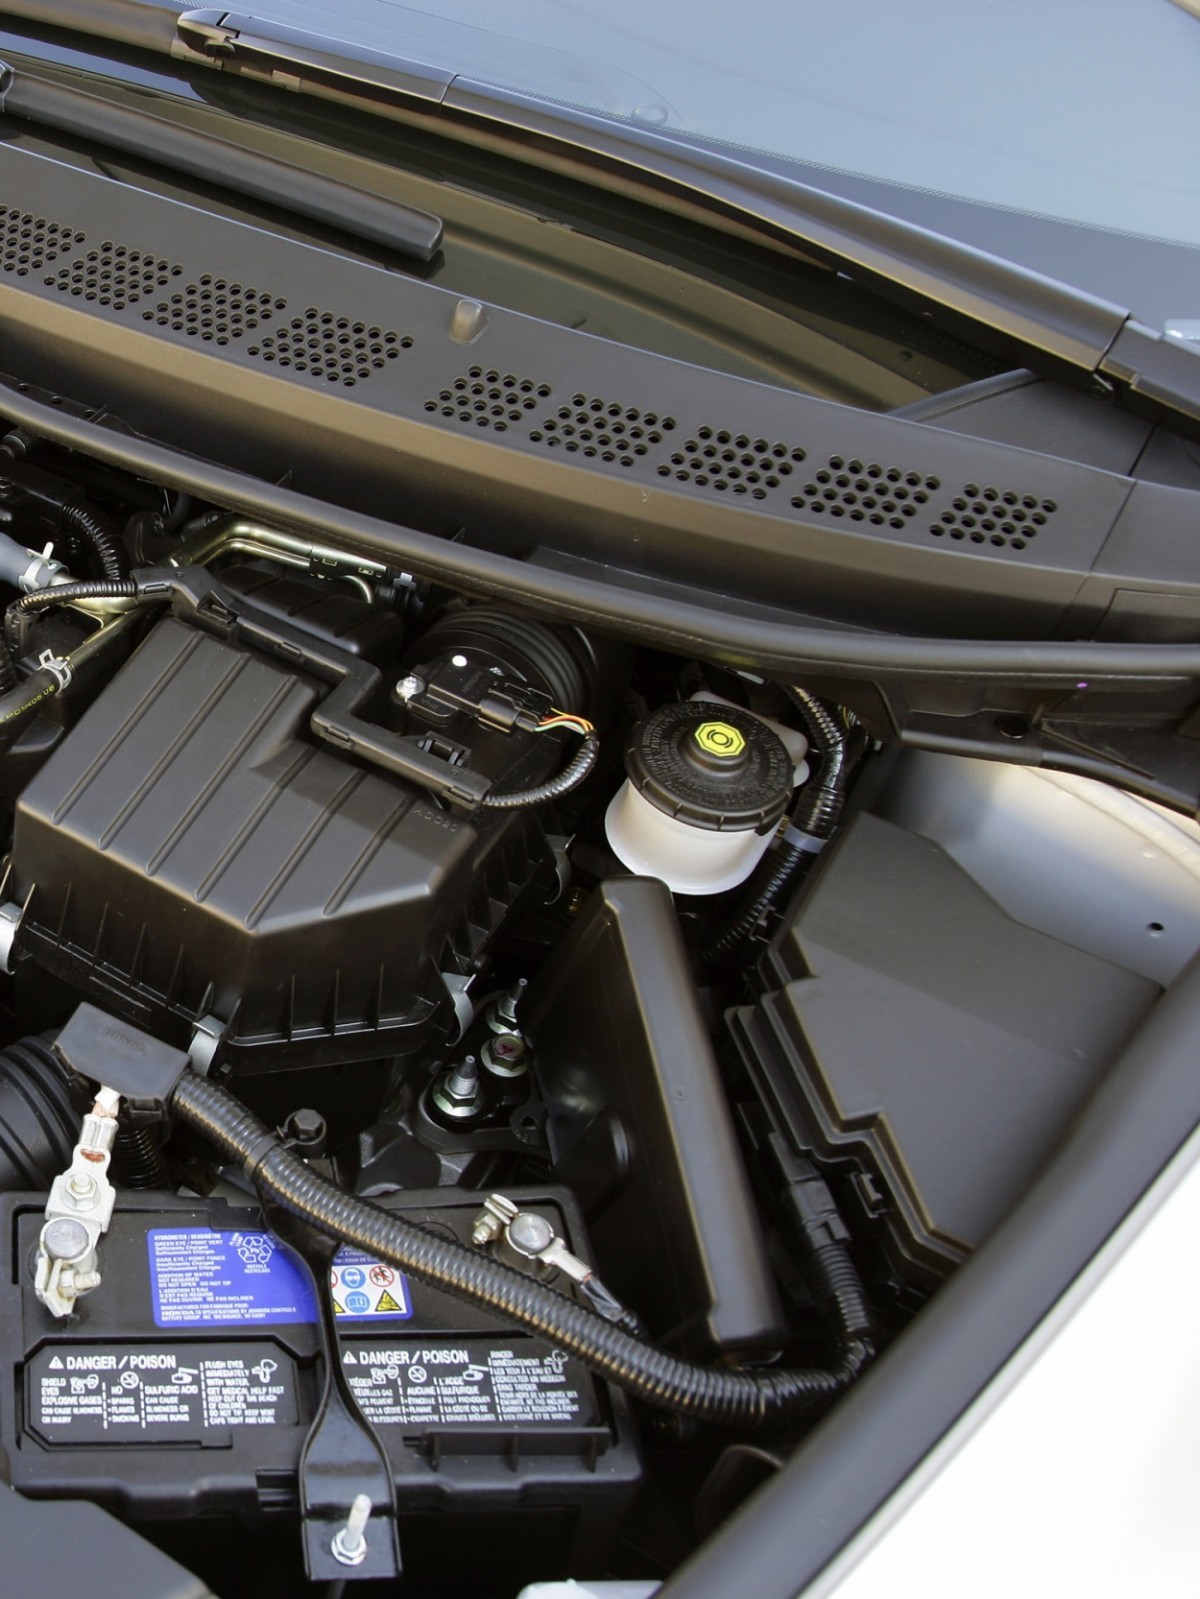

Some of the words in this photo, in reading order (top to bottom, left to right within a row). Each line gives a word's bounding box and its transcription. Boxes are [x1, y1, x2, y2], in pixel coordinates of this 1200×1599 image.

[359, 1351, 410, 1365] DANGER
[421, 1350, 470, 1364] POISON
[66, 1356, 117, 1370] DANGER
[129, 1355, 177, 1369] POISON
[205, 1361, 227, 1369] FLUSH
[227, 1360, 244, 1369] EYES
[41, 1378, 67, 1387] SHIELD
[41, 1387, 60, 1396] EYES
[110, 1386, 123, 1395] NO
[144, 1386, 180, 1395] SULFURIC
[180, 1385, 199, 1394] ACID
[41, 1396, 79, 1405] EXPLOSIVE
